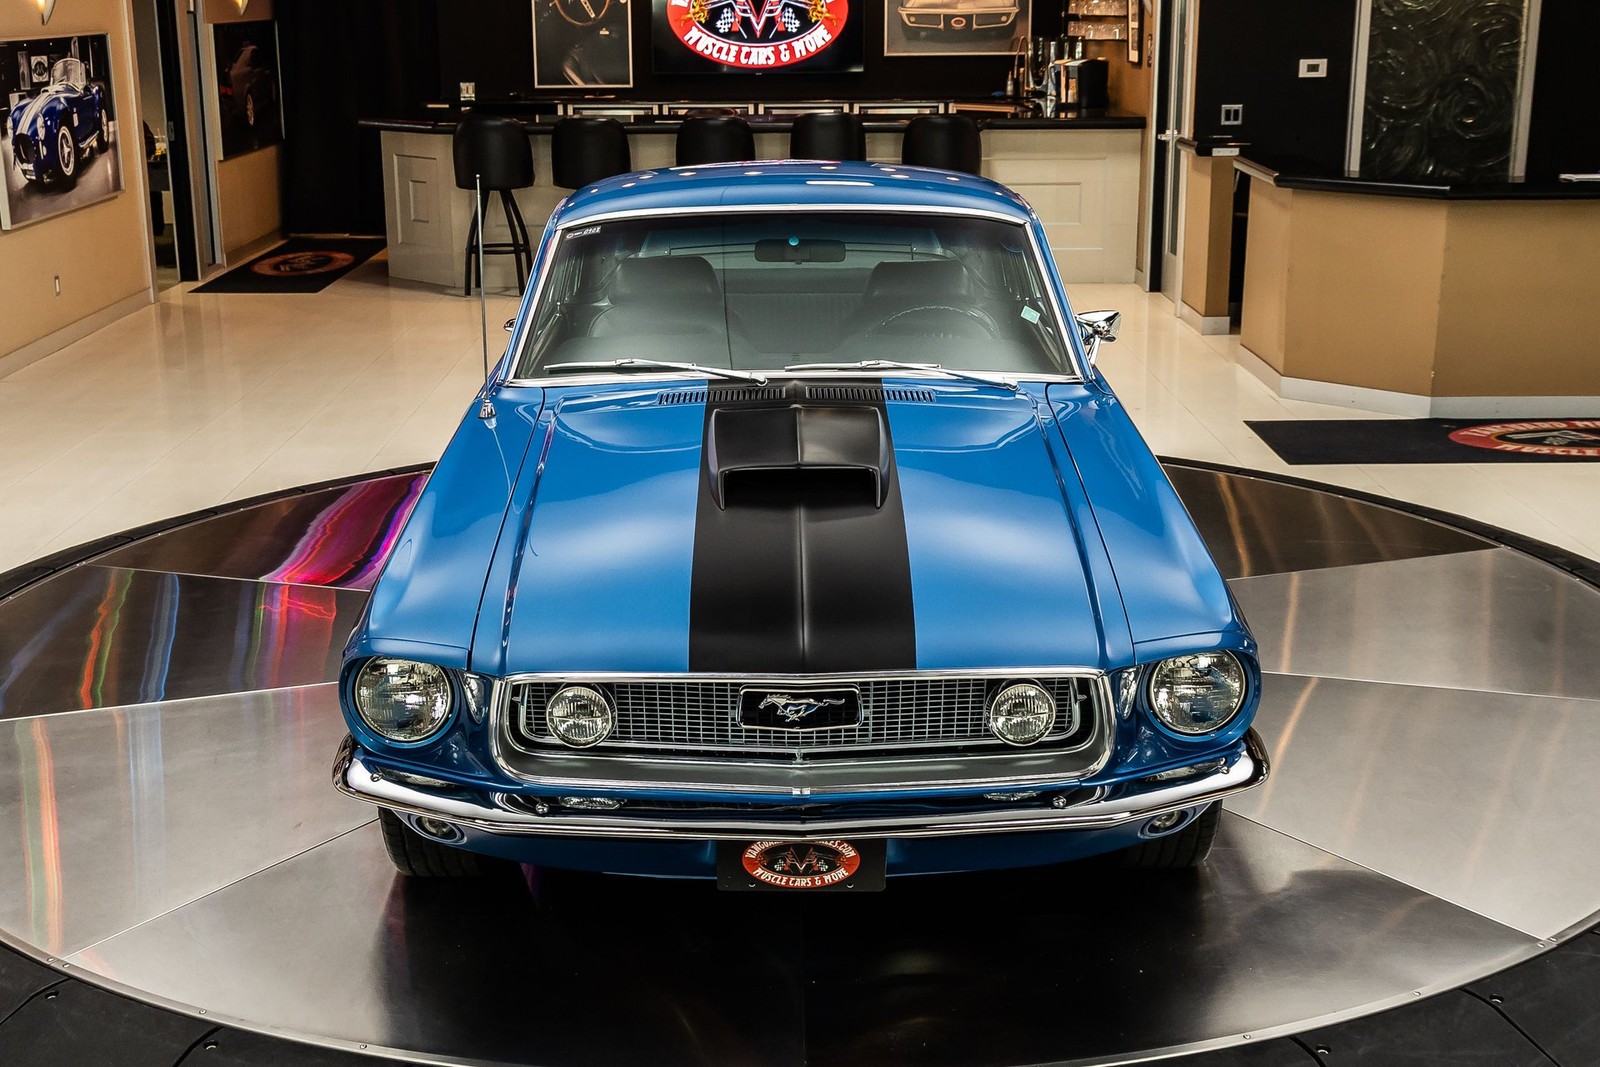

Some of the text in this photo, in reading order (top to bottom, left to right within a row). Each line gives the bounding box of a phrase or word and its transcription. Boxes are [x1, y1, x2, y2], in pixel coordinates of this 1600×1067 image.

[683, 24, 833, 65] MUSCLE CARS & MORE
[1494, 443, 1600, 456] MUSCLE
[752, 867, 849, 887] MUSCLE CARS & MORE
